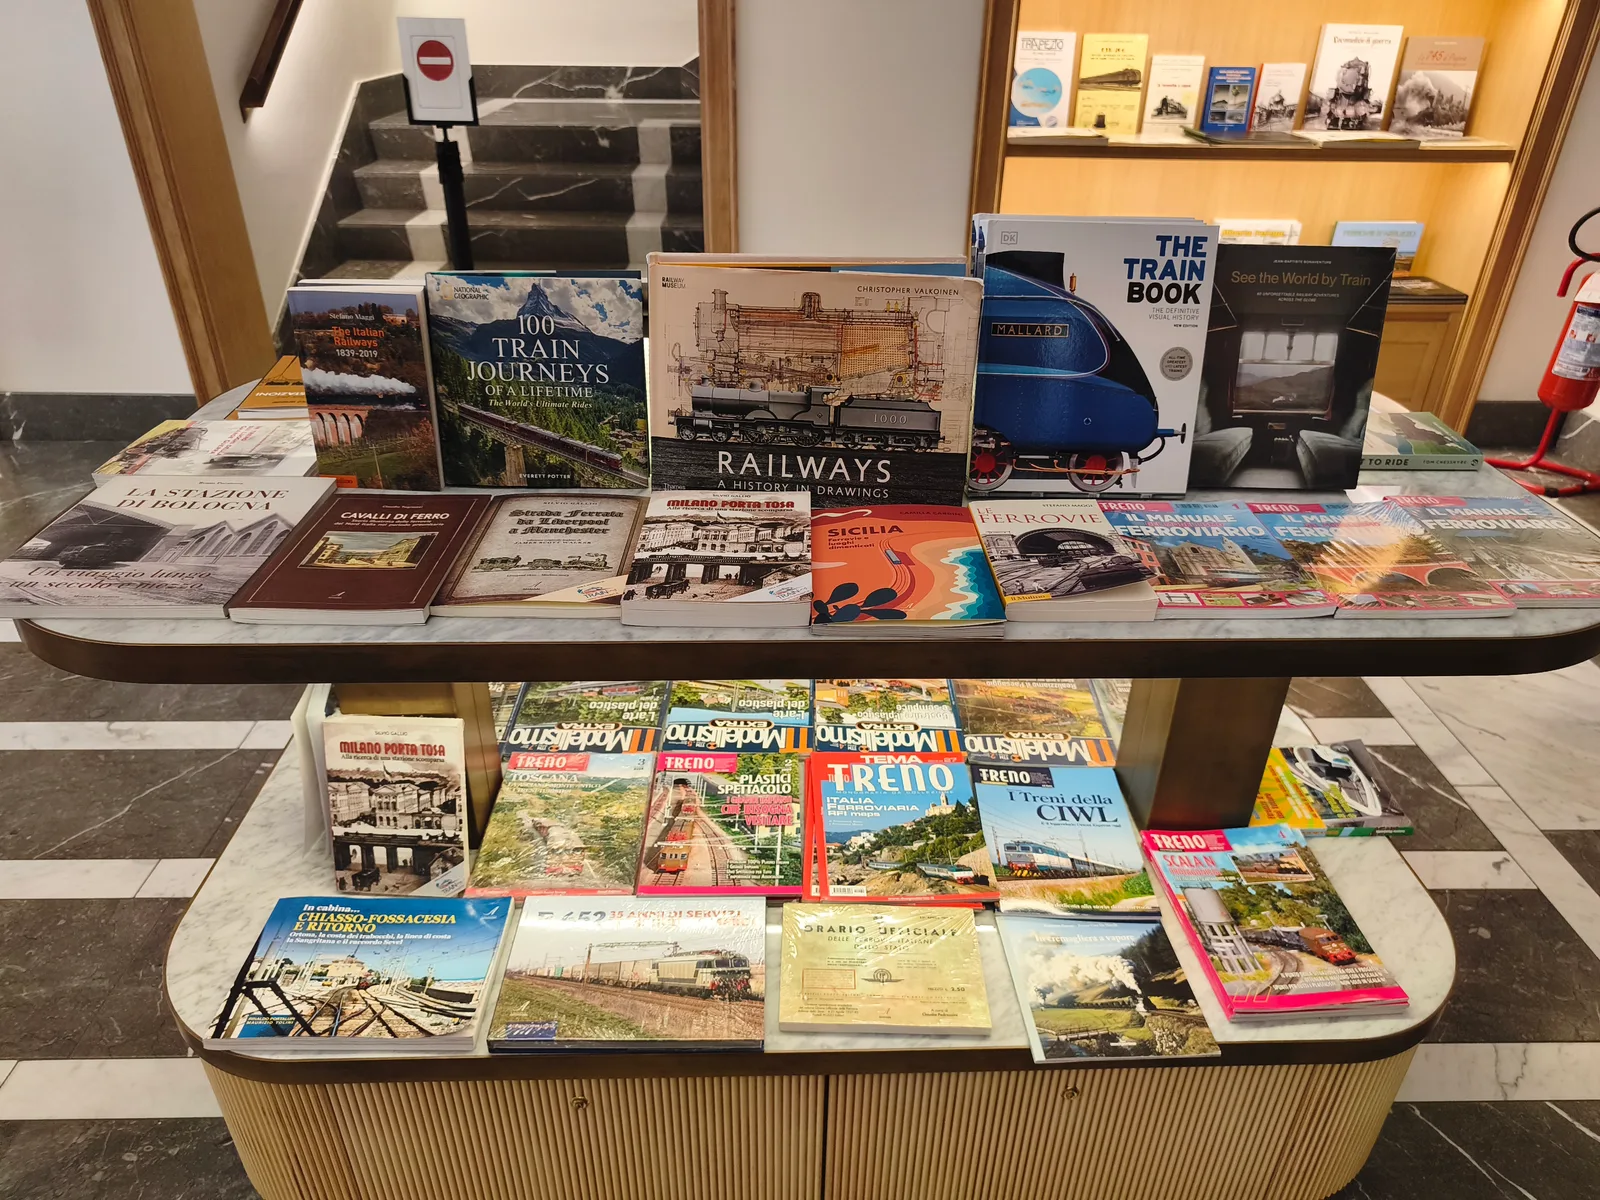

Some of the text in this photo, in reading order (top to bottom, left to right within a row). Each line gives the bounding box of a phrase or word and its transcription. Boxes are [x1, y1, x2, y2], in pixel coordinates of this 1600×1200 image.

[1003, 233, 1016, 242] DK
[1156, 235, 1208, 258] THE
[1123, 258, 1206, 281] TRAIN
[1231, 270, 1371, 288] See the World by Train
[453, 286, 481, 294] NATIONAL
[857, 285, 960, 296] CHRISTOPHER VALKOINEN
[1127, 282, 1201, 304] BOOK
[453, 292, 489, 301] GEOGRAPHIC
[1152, 307, 1200, 315] THE DEFINITIVE
[329, 312, 375, 322] Stefano Maggi
[518, 314, 555, 337] 100
[996, 324, 1063, 336] MALLARD
[331, 325, 385, 338] The Italian
[333, 335, 378, 349] Railways
[335, 348, 378, 358] 1839-2019
[492, 337, 580, 361] TRAIN
[467, 360, 609, 385] JOURNEYS
[485, 385, 593, 398] OF A LIFETIME
[488, 399, 592, 409] The World's Ultimate Rides
[873, 413, 907, 424] 1000
[717, 451, 892, 484] RAILWAYS
[1368, 458, 1410, 466] TO RIDE
[126, 487, 289, 499] LA STAZIONE
[717, 480, 889, 499] A HISTORY IN DRAWINGS
[116, 499, 272, 511] DI BOLOGNA
[666, 499, 795, 509] MILANO PORTA TOSA
[1099, 501, 1146, 511] TRENO
[1253, 503, 1300, 513] TRENO
[508, 509, 624, 518] Strada Ferrata
[977, 507, 994, 515] LE
[1427, 507, 1539, 517] IL MANUALE
[538, 518, 611, 527] Liverpool
[979, 513, 1102, 524] FERROVIE
[1125, 513, 1237, 523] IL MANUALE
[1281, 514, 1301, 523] IL
[1421, 518, 1573, 531] FERROVIARIO
[520, 526, 611, 535] Manchester
[827, 525, 904, 537] SICILIA
[1114, 525, 1266, 538] FERROVIARIO
[28, 566, 212, 580] Un viaggio lungo
[9, 580, 204, 591] un secolo mezzo
[589, 700, 658, 711] del plastico
[738, 699, 805, 710] del plastico
[895, 703, 938, 713] semplice
[622, 711, 655, 721] L'arte
[772, 709, 805, 720] L'arte
[560, 722, 616, 730] EXTRA
[713, 720, 768, 728] EXTRA
[860, 723, 914, 731] EXTRA
[1008, 731, 1064, 740] EXTRA
[339, 741, 446, 756] MILANO PORTA TOSA
[516, 755, 567, 768] TRENO
[664, 756, 715, 769] TRENO
[860, 754, 923, 764] TEMA
[510, 772, 579, 782] TOSCANA
[739, 774, 792, 784] PLASTICI
[827, 763, 955, 792] TRENO
[979, 768, 1031, 784] TRENO
[717, 783, 792, 795] SPETTACOLO
[826, 796, 874, 804] ITALIA
[1018, 791, 1113, 805] Treni della
[721, 804, 793, 815] CHE BISOGNA
[827, 803, 919, 812] FERROVIARIA
[1036, 804, 1119, 823] CIWL
[744, 814, 793, 826] VISITARE
[1150, 833, 1207, 849] TRENO
[1162, 854, 1204, 868] SCALA
[303, 903, 360, 914] In cabina...
[298, 912, 457, 925] CHIASSO-FOSSACESIA
[292, 921, 377, 933] E RITORNO
[804, 924, 866, 934] ORARIO
[289, 931, 317, 939] Ortona,
[294, 937, 336, 946] Sangritana
[383, 938, 404, 946] Sevel
